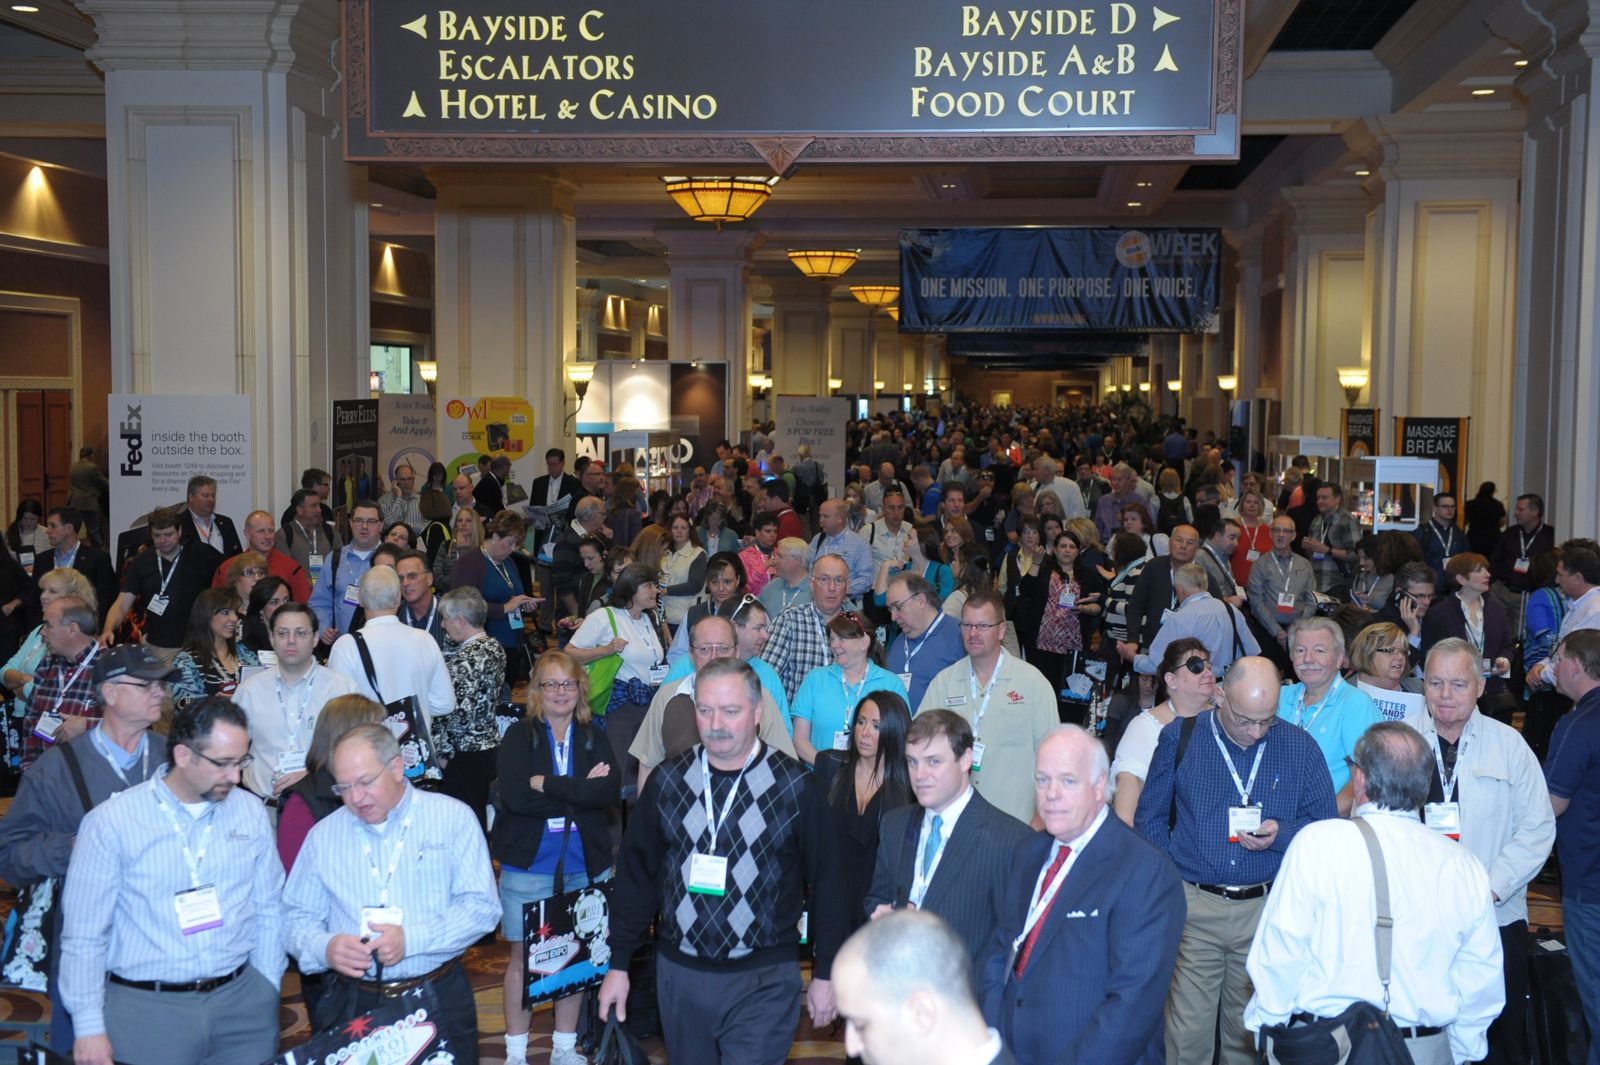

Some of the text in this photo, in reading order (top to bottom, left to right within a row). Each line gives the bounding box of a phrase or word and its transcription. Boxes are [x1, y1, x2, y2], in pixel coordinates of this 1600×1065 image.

[438, 9, 605, 45] BAYSIDE C
[961, 3, 1137, 40] BAYSIDE D
[438, 49, 634, 82] ESCALATORS
[913, 46, 1047, 81] BAYSIDE
[439, 88, 718, 121] HOTEL & CASINO
[910, 85, 1136, 118] FOOD COURT
[1149, 232, 1219, 256] WEEK
[920, 277, 1198, 298] ONE MISSION. ONE PURPOSE. ONE VOICE.
[395, 400, 433, 409] Join Toda
[446, 399, 488, 420] Owl
[402, 416, 420, 425] Take
[120, 403, 143, 477] FedEx
[151, 430, 247, 443] inside the booth.
[390, 426, 433, 437] And Apply
[1406, 425, 1457, 438] MASSAGE
[151, 444, 244, 456] outside the box.
[1373, 698, 1407, 712] BETTER
[1378, 707, 1406, 719] ANDS
